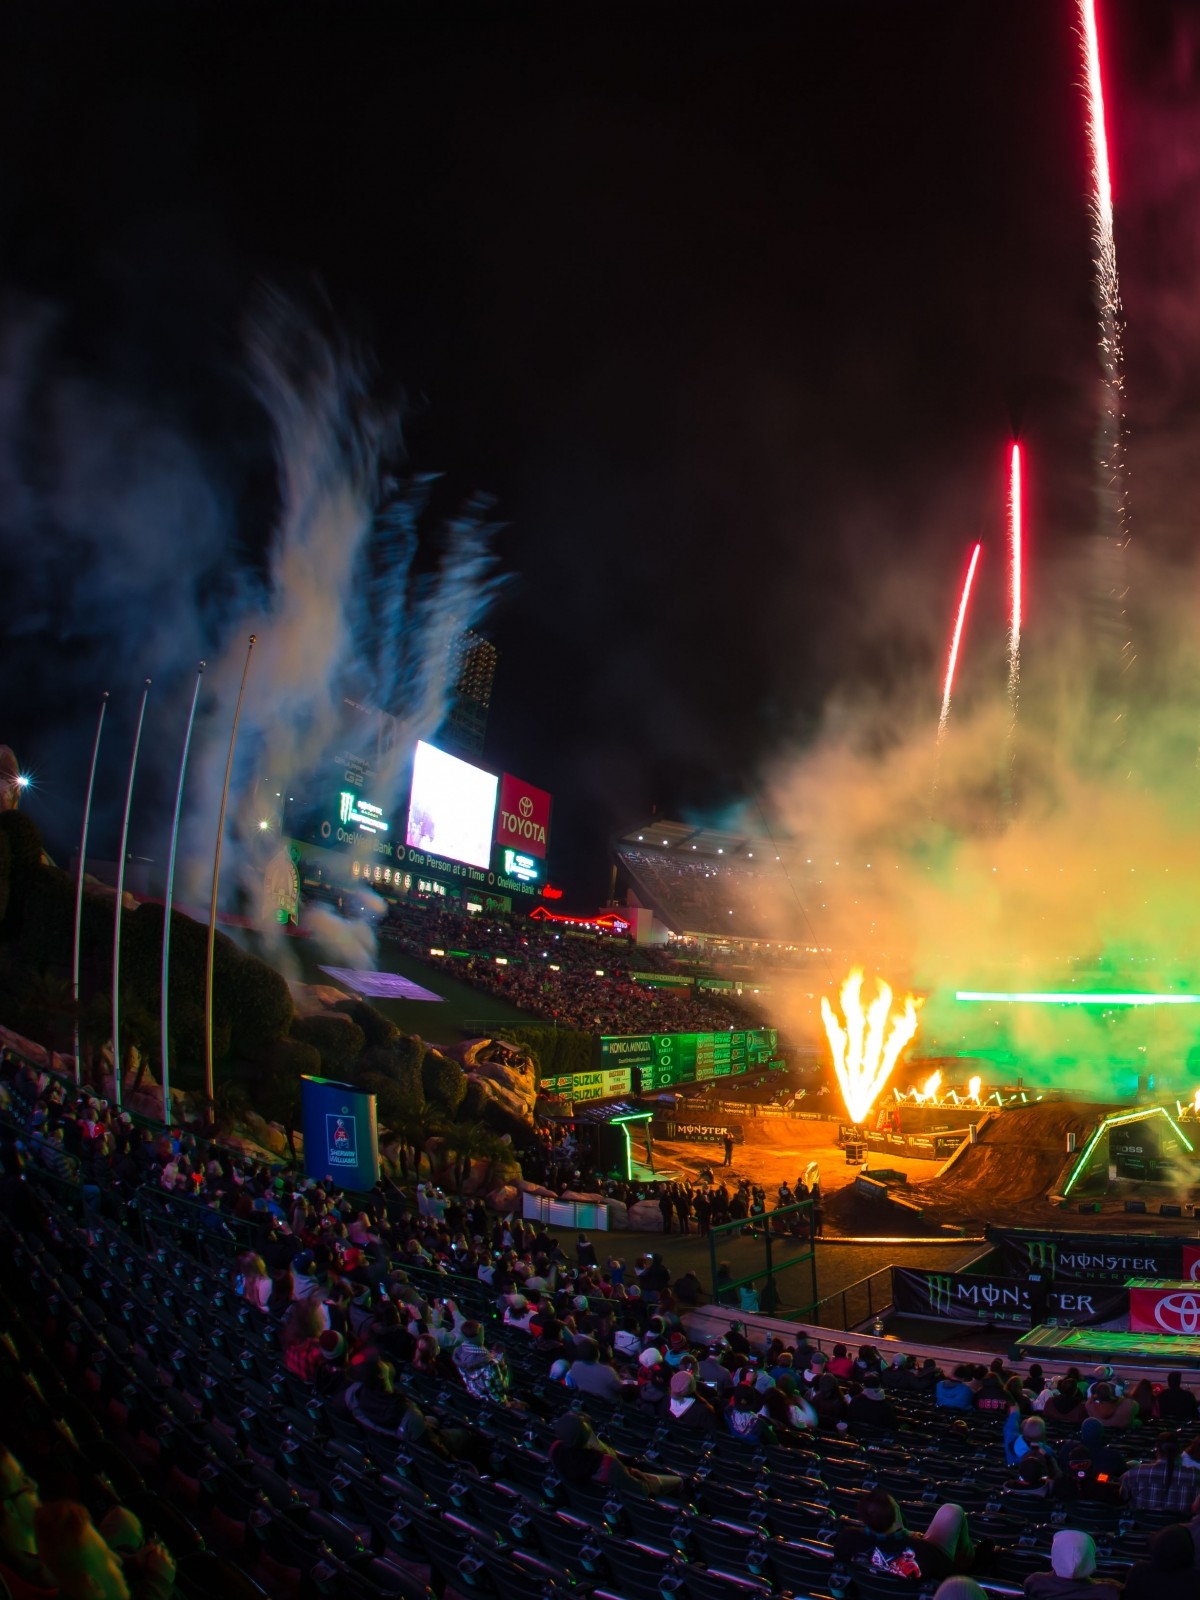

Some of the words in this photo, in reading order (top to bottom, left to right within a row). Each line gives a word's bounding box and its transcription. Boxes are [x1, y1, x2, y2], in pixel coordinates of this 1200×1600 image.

[501, 810, 546, 845] TOYOTA
[409, 849, 425, 864] One
[426, 855, 452, 872] Person
[452, 865, 460, 875] at
[462, 868, 467, 877] a
[468, 866, 485, 881] Time
[497, 875, 521, 891] OneWest
[521, 883, 535, 896] Bank
[573, 1073, 603, 1087] SUZUKI
[573, 1087, 603, 1100] SUZUKI
[677, 1124, 729, 1135] MONSTER
[330, 1148, 356, 1157] SHERWIN
[1060, 1252, 1159, 1272] MONSTER
[957, 1283, 1096, 1314] MONER
[978, 1310, 1074, 1326] ENEGY
